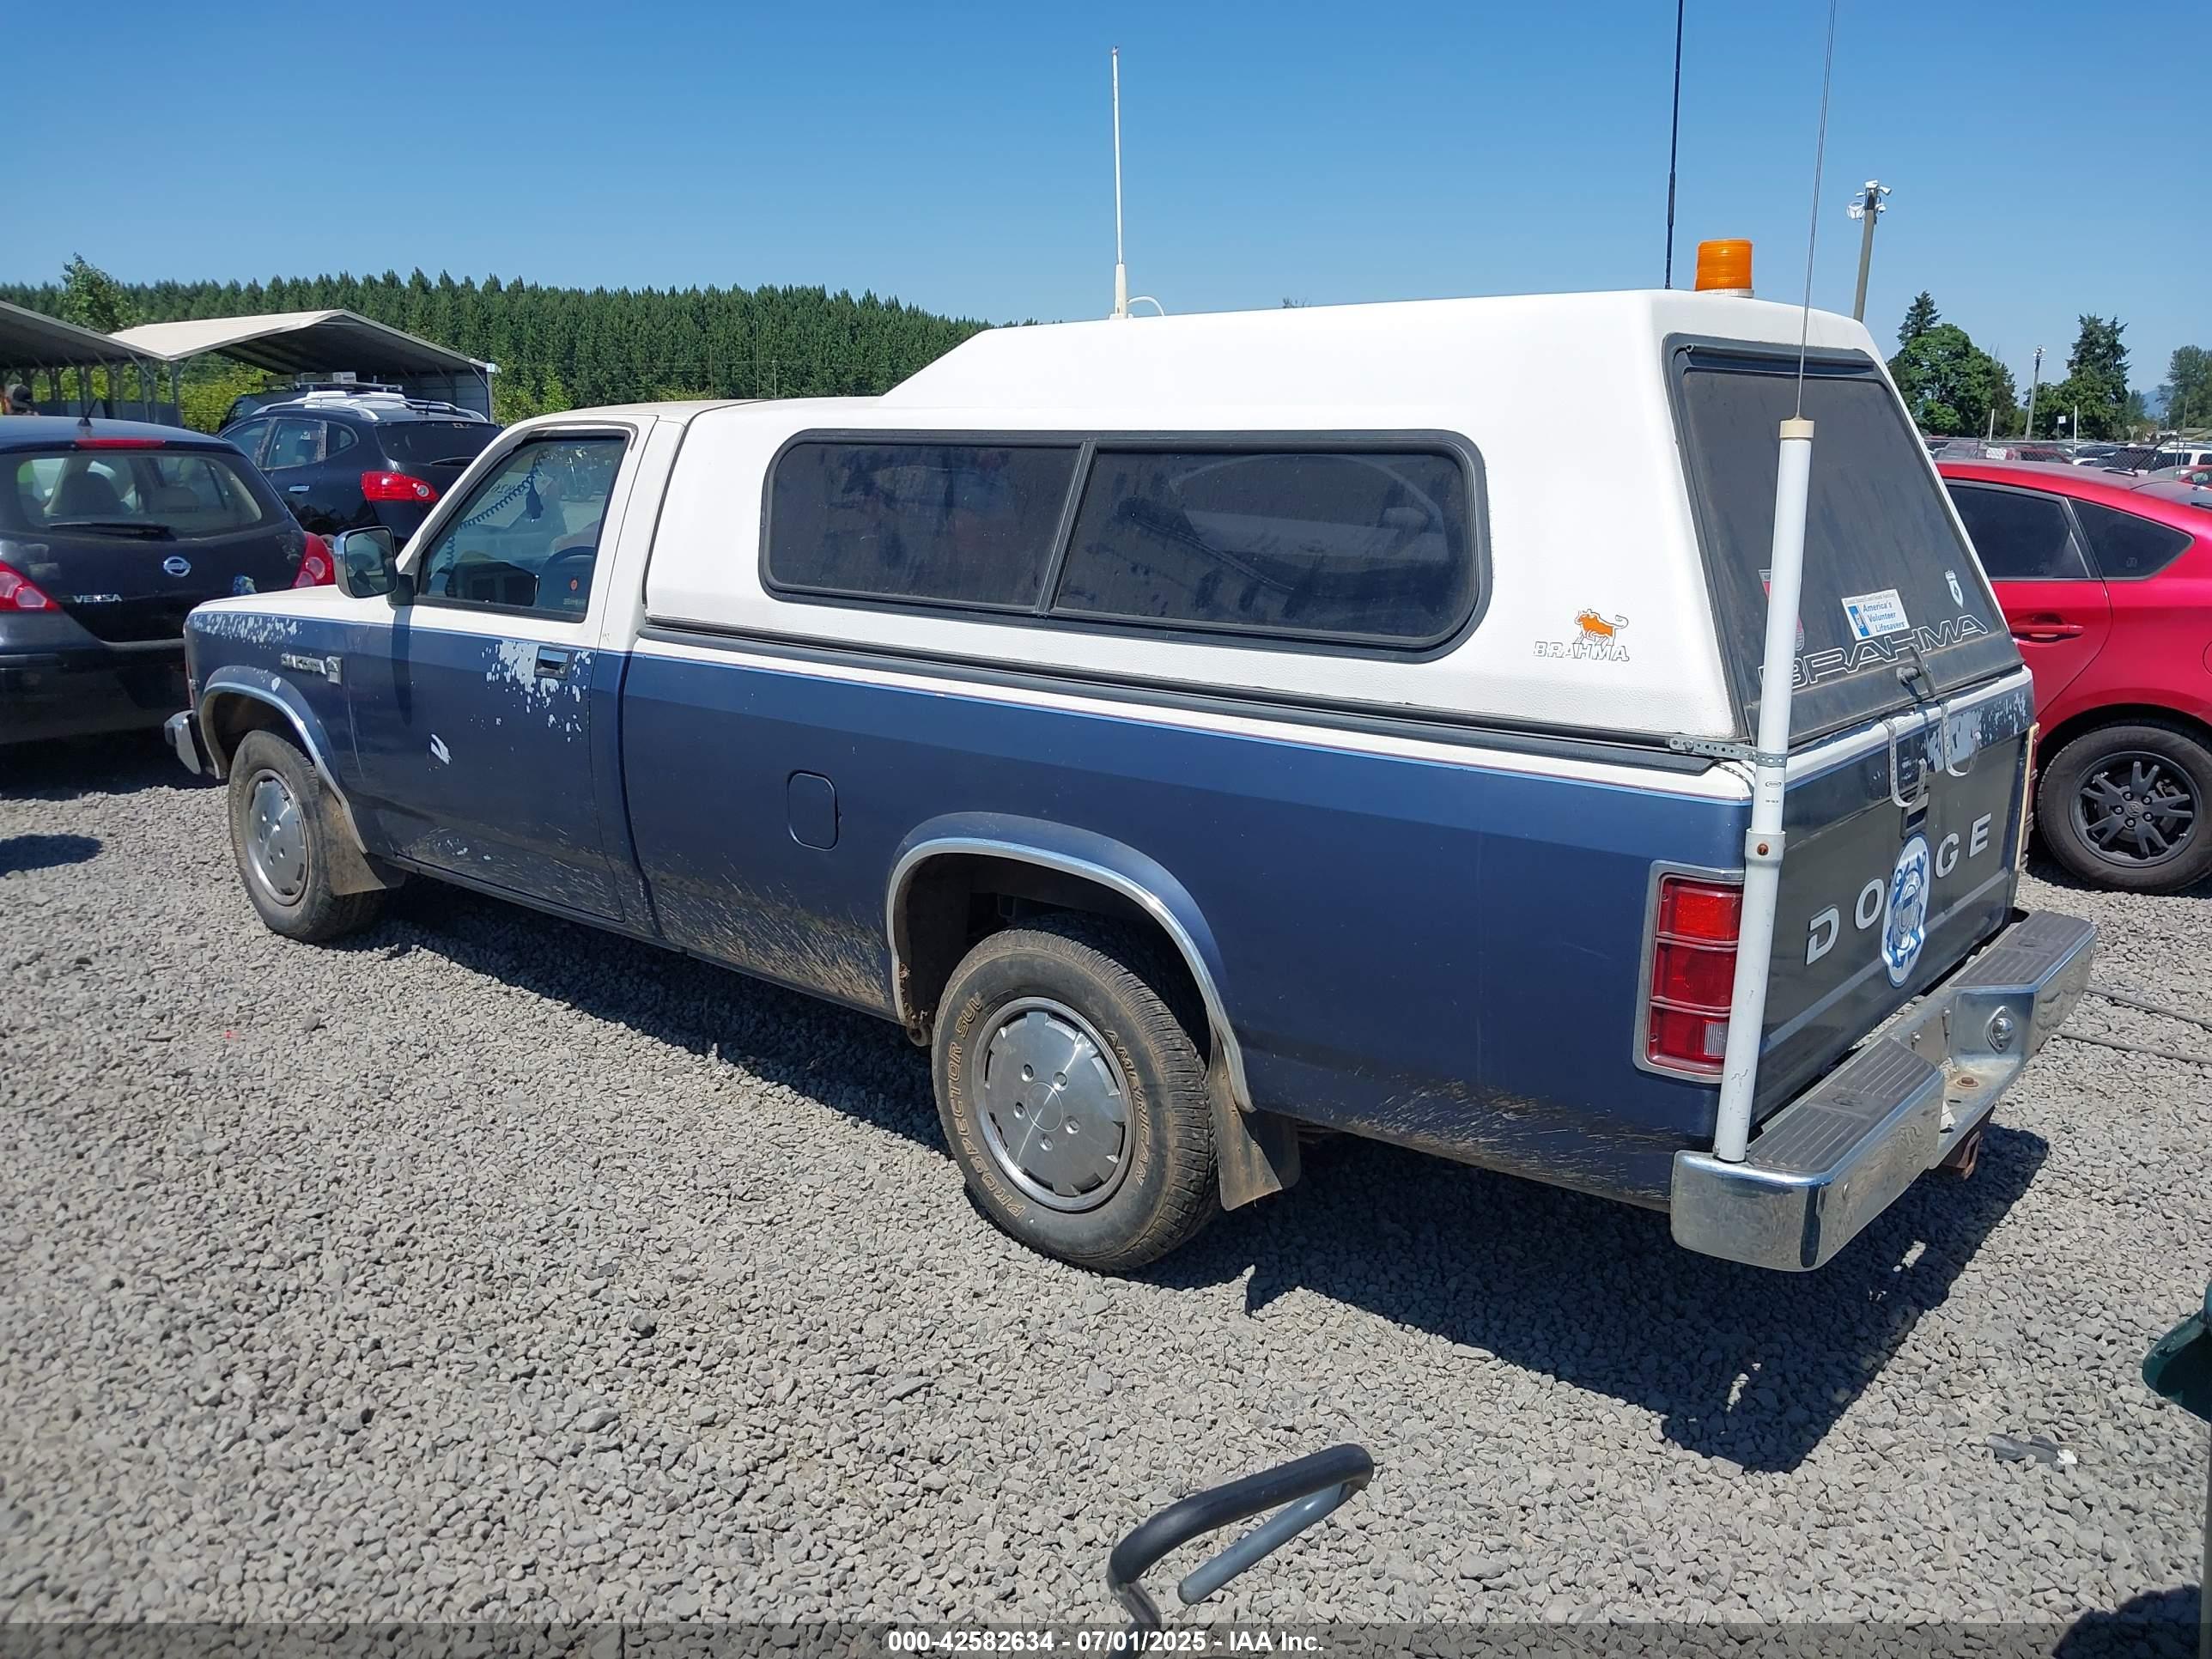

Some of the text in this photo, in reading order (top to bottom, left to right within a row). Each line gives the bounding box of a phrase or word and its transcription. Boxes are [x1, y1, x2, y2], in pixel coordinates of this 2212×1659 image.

[73, 593, 123, 604] VERSA
[1863, 601, 1893, 612] America's
[1867, 612, 1896, 623] Volunteer
[1875, 621, 1905, 632] Lifesavers
[1533, 641, 1630, 661] BRAHMA
[1805, 812, 1992, 965] DOGE
[946, 1041, 1026, 1219] PROSPECTOR
